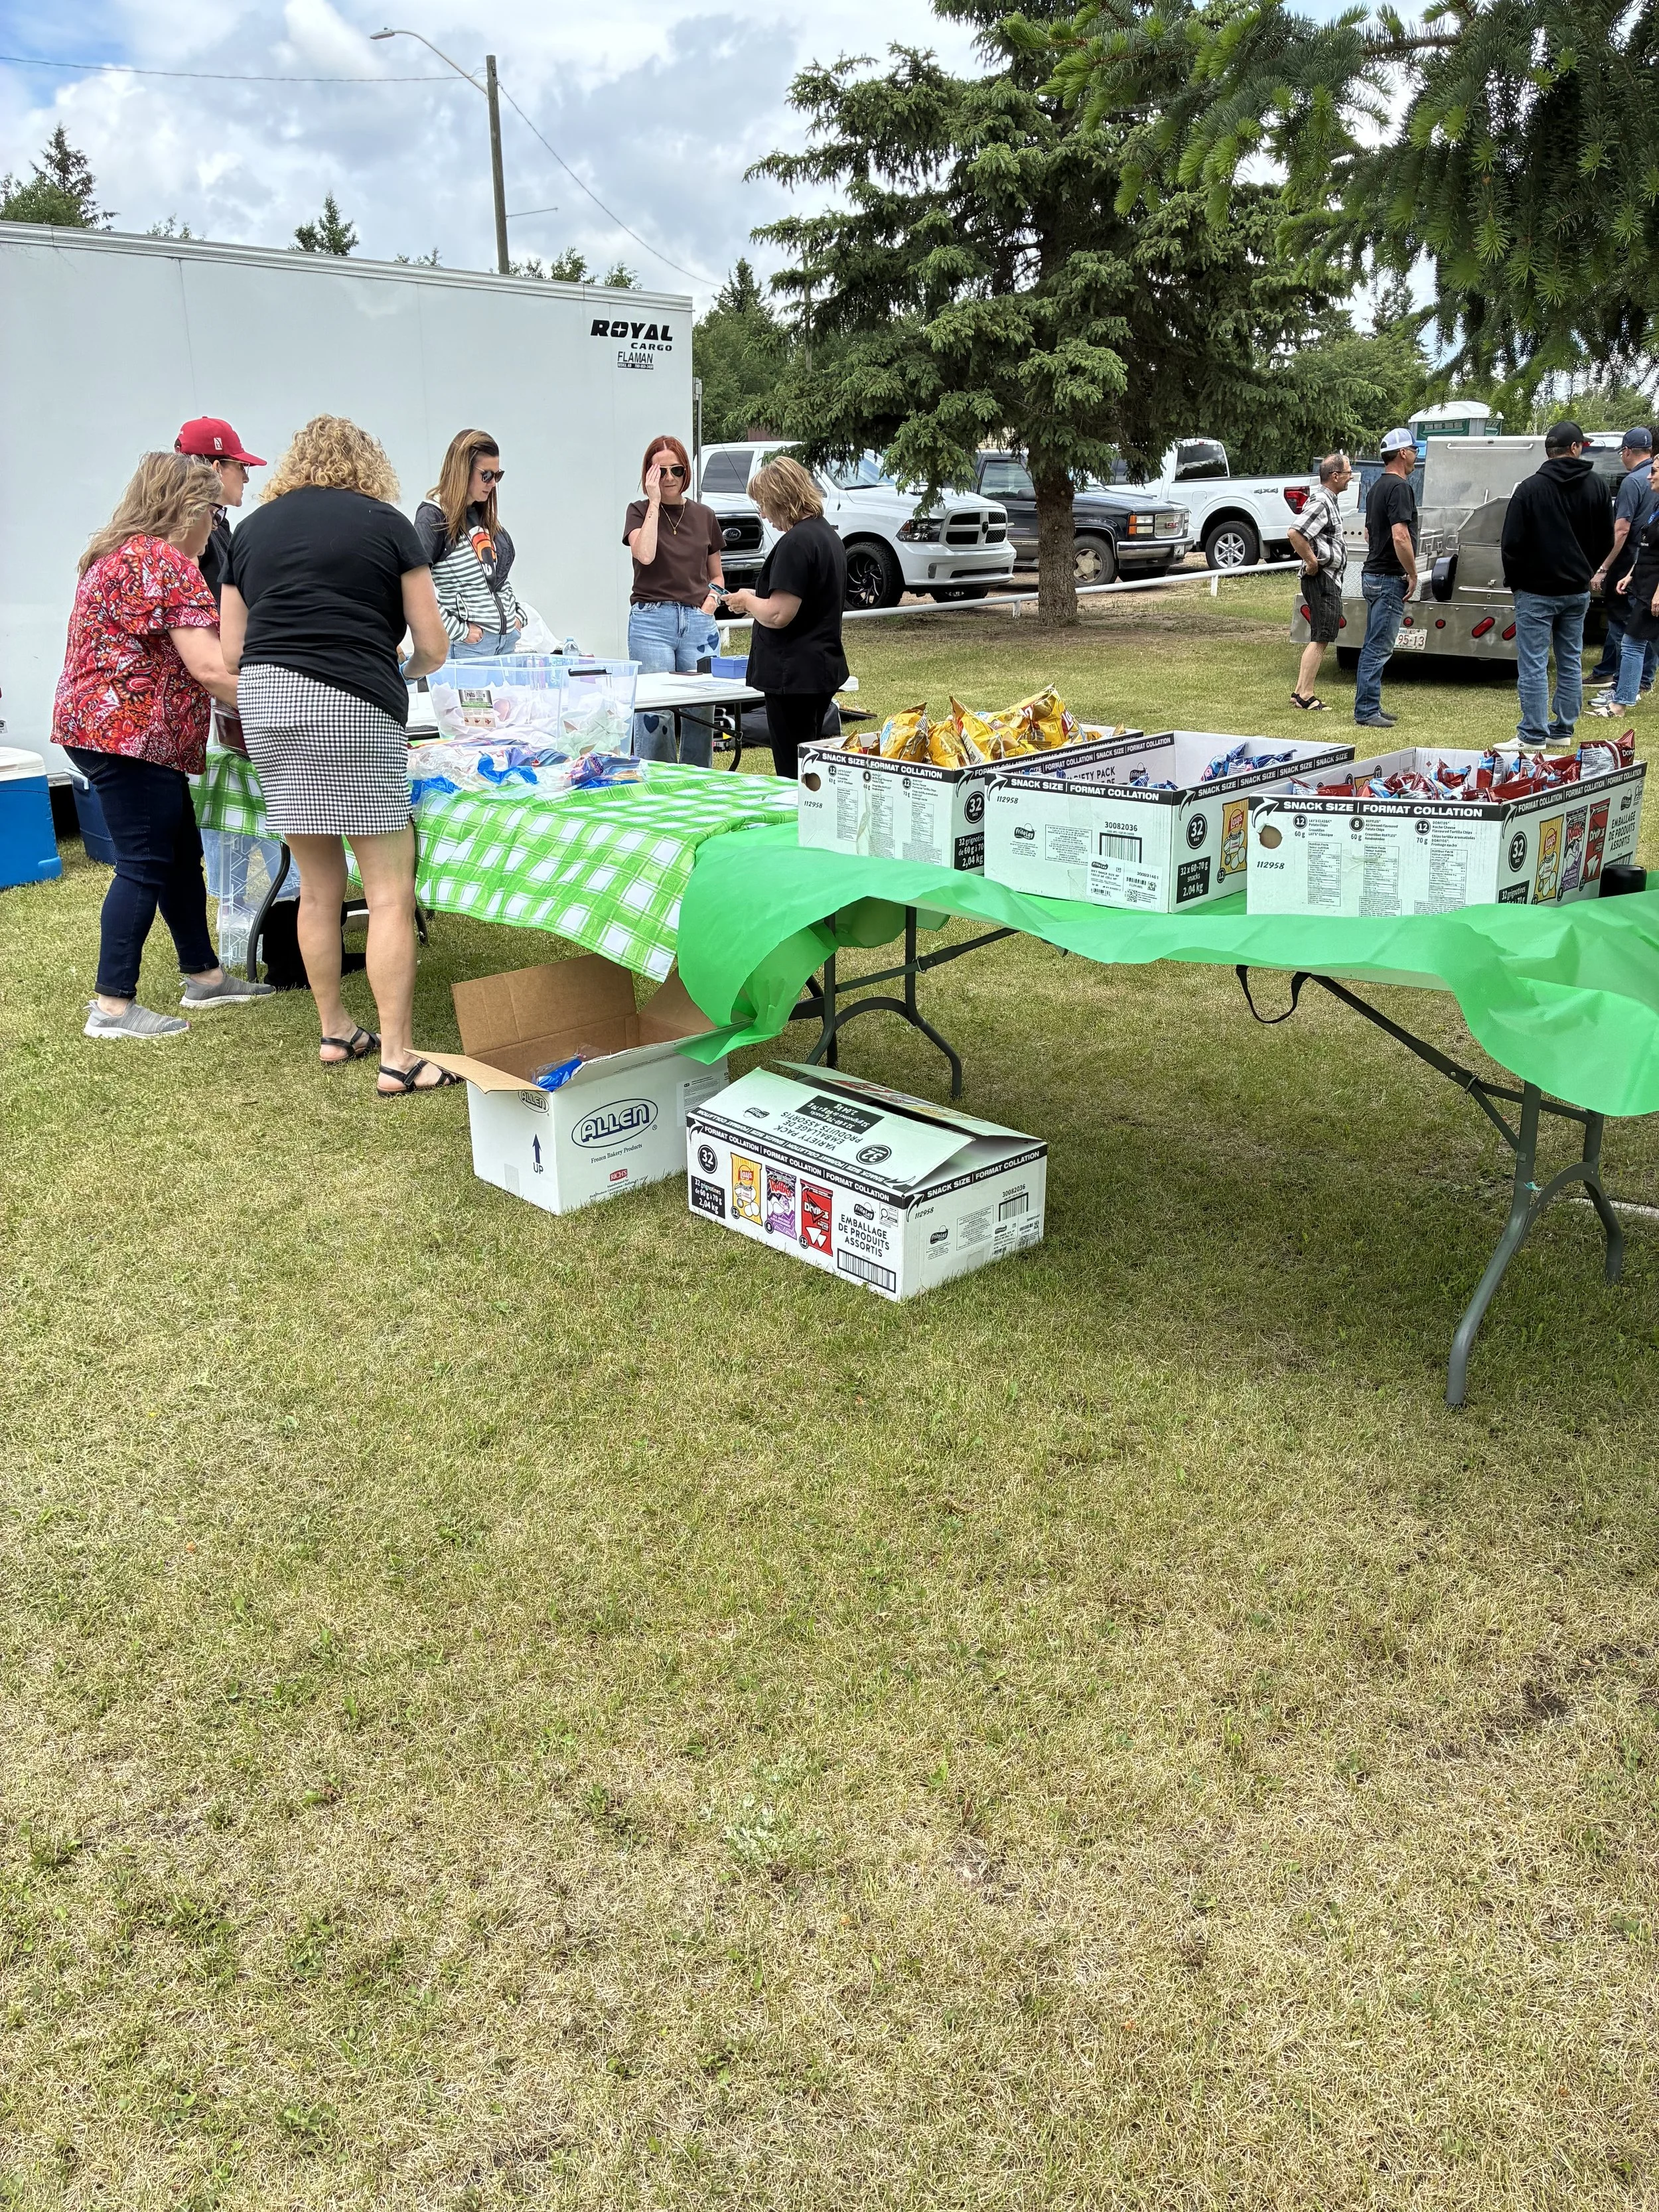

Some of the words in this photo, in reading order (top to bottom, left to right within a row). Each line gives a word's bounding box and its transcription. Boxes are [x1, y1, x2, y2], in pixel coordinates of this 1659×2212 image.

[591, 319, 673, 341] ROYAL
[631, 342, 672, 352] CARGO
[618, 351, 653, 363] FLAMAN
[1127, 743, 1146, 753] FORMAT
[1146, 737, 1171, 749] COLLATION
[822, 753, 847, 763] SNACK
[847, 757, 865, 766] SIZE
[1096, 749, 1113, 760] SNACK
[1114, 747, 1125, 756] SIZE
[1316, 756, 1334, 767] SNACK
[1335, 752, 1348, 763] SIZE
[870, 761, 899, 772] FORMAT
[901, 766, 942, 779] COLLATION
[1045, 759, 1065, 771] FORMAT
[1066, 754, 1093, 766] COLLATION
[1279, 765, 1299, 776] SNACK
[1300, 761, 1313, 771] SIZE
[1097, 766, 1116, 779] PACK
[1240, 776, 1261, 788] SNACK
[1262, 772, 1276, 782] SIZE
[1607, 775, 1623, 786] FORMAT
[1623, 768, 1642, 780] COLLATION
[1011, 778, 1041, 788] SNACK
[1043, 782, 1064, 791] SIZE
[1198, 786, 1220, 796] SNACK
[1221, 782, 1237, 792] SIZE
[1565, 786, 1584, 797] FORMAT
[1584, 780, 1605, 792] COLLATION
[997, 796, 1019, 804] 112958
[1070, 785, 1106, 796] FORMAT
[1108, 788, 1159, 801] COLLATION
[969, 797, 982, 813] 32
[1283, 800, 1323, 811] SNACK
[1325, 802, 1354, 812] SIZE
[1518, 800, 1538, 813] FORMAT
[1539, 792, 1563, 806] COLLATION
[1363, 804, 1410, 814] FORMAT
[1413, 805, 1483, 817] COLLATION
[1104, 821, 1138, 832] 30082036
[1611, 810, 1636, 829] EMBALLAGE
[1191, 820, 1204, 838] 32
[1608, 830, 1615, 842] DE
[1615, 822, 1636, 839] PRODUITS
[958, 838, 965, 846] 32
[978, 843, 983, 851] 70
[1512, 839, 1524, 858] 32
[1610, 834, 1630, 852] ASSORTIS
[975, 854, 983, 864] kg
[1257, 861, 1285, 869] 112958
[1180, 867, 1187, 875] 32
[1190, 862, 1204, 873] 60-70
[1205, 861, 1208, 870] g
[1187, 873, 1200, 882] snacks
[1196, 883, 1203, 894] kg
[1502, 890, 1508, 901] 32
[1508, 886, 1526, 899] grignotines
[521, 1090, 546, 1110] ALLEN
[581, 1104, 650, 1143] ALLEN
[697, 1110, 728, 1123] COLLATION
[780, 1112, 822, 1128] ASSORTIS
[727, 1121, 750, 1133] FORMAT
[773, 1125, 800, 1137] PACK
[794, 1124, 845, 1144] EMBALLAGE
[820, 1125, 863, 1143] PRODUITS
[704, 1126, 729, 1140] FORMAT
[729, 1135, 759, 1152] COLLATION
[763, 1135, 786, 1145] SNACK
[798, 1134, 836, 1151] VARIETY
[591, 1155, 607, 1164] Frozen
[607, 1149, 622, 1159] Bakery
[623, 1143, 642, 1153] Products
[701, 1149, 714, 1165] 32
[786, 1143, 820, 1158] COLLATION
[861, 1149, 883, 1162] 32
[533, 1163, 543, 1175] UP
[763, 1147, 788, 1163] FORMAT
[789, 1158, 822, 1176] COLLATION
[819, 1156, 843, 1168] FORMAT
[975, 1165, 1002, 1180] FORMAT
[1003, 1150, 1040, 1169] COLLATION
[861, 1171, 885, 1183] SNACK
[701, 1183, 721, 1195] grignotines
[826, 1171, 852, 1187] FORMAT
[854, 1182, 890, 1202] COLLATION
[927, 1183, 952, 1198] SNACK
[954, 1177, 971, 1189] SIZE
[1002, 1183, 1026, 1198] 30082036
[699, 1197, 711, 1209] 2,04
[711, 1203, 719, 1215] kg
[914, 1207, 934, 1219] 112958
[841, 1214, 887, 1239] EMBALLAGE
[838, 1222, 848, 1234] DE
[850, 1228, 890, 1250] PRODUITS
[845, 1236, 883, 1257] ASSORTIS
